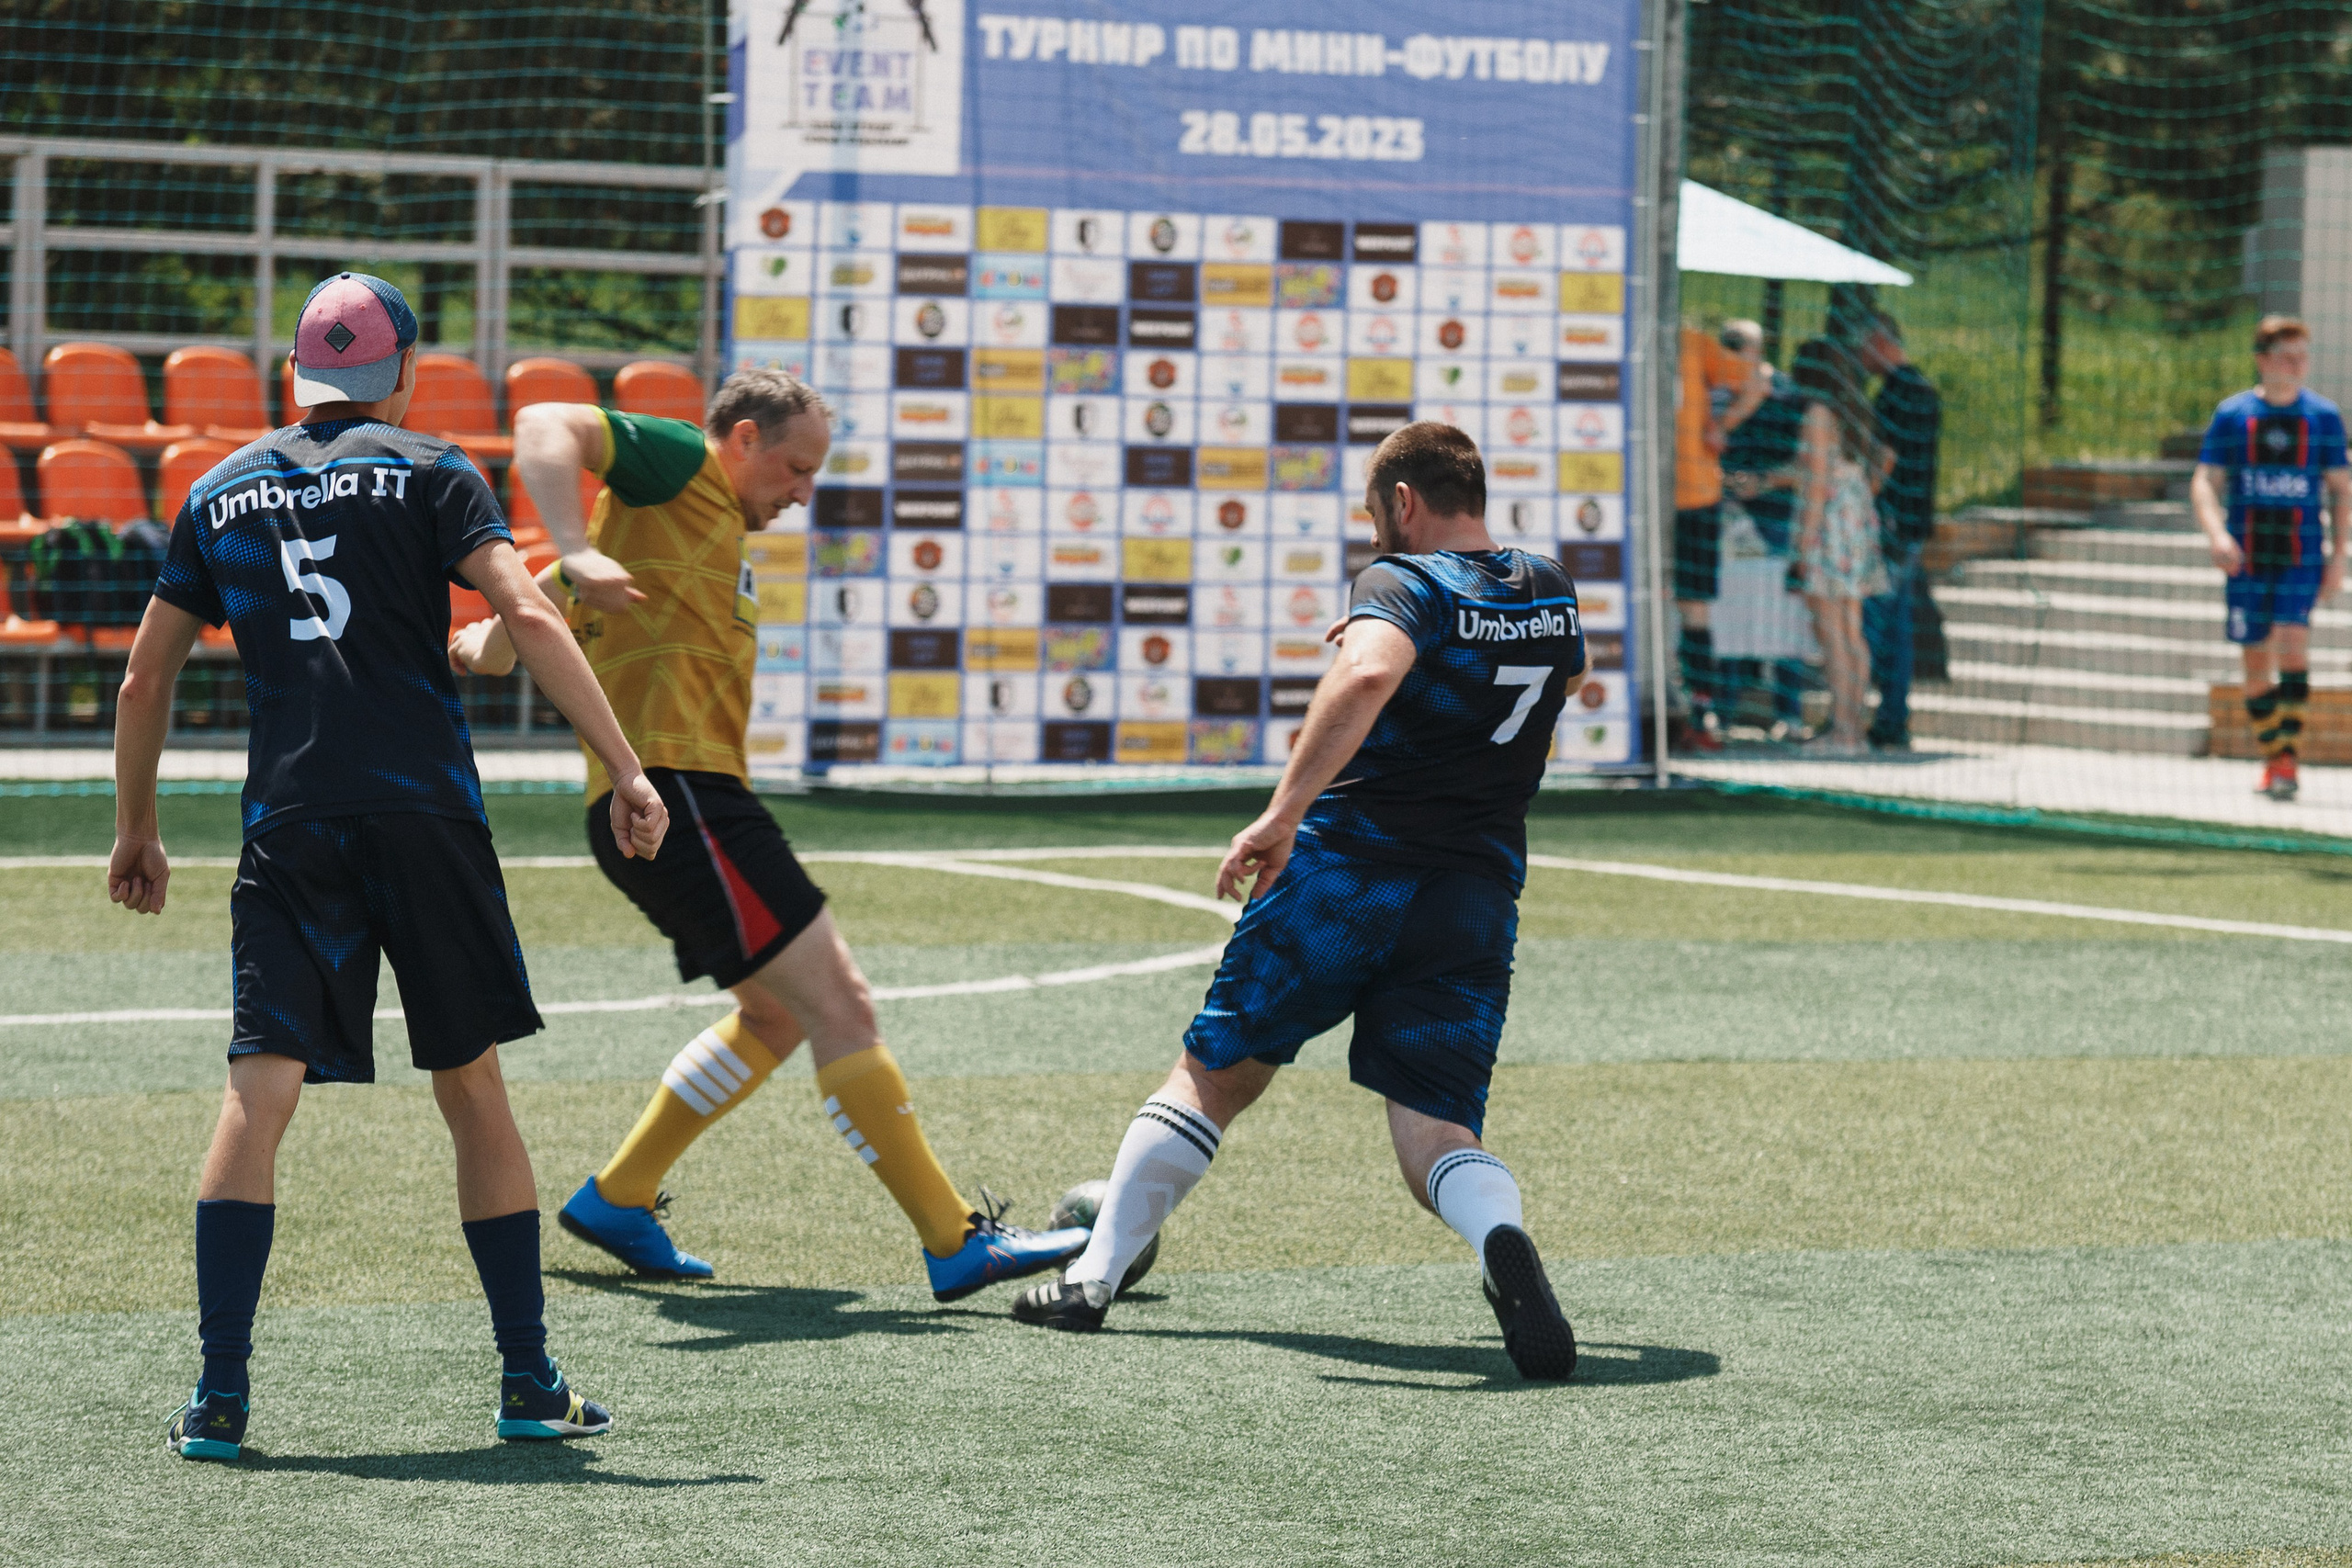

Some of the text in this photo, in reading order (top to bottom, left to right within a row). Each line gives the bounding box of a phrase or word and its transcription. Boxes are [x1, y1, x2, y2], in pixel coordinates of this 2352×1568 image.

[803, 49, 912, 78] EVENT
[978, 15, 1611, 85] ТУРНИР ПО МИНИ-ФУТБОЛУ
[802, 82, 912, 111] TEAM
[1180, 110, 1425, 162] 28.05.2023
[208, 467, 412, 530] Umbrella IT
[281, 535, 351, 641] 5
[1458, 608, 1565, 641] Umbrella
[1490, 665, 1555, 745] 7
